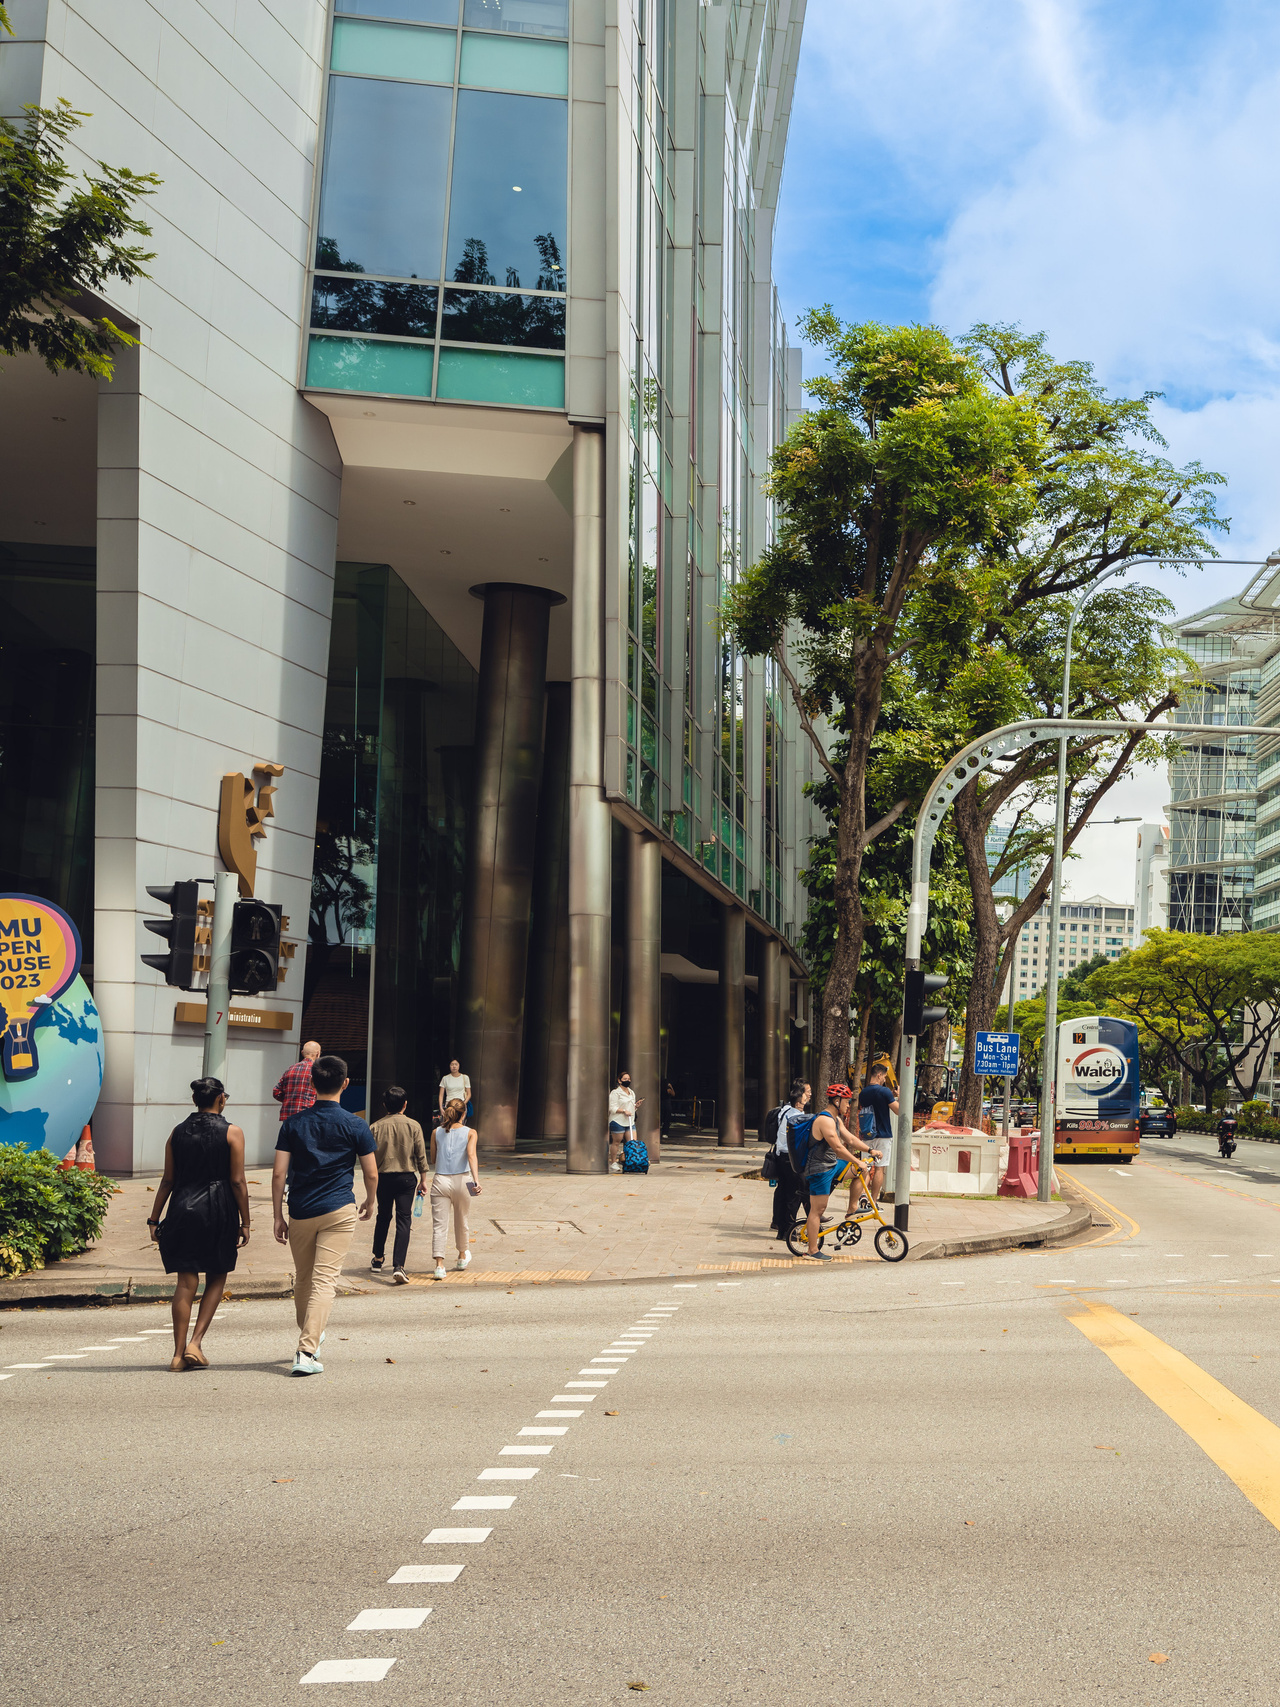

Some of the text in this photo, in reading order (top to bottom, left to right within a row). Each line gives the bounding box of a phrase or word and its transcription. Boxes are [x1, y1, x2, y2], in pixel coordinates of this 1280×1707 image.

[0, 917, 42, 939] MU
[0, 939, 42, 956] PEN
[0, 973, 42, 990] 023
[216, 1011, 223, 1025] 7
[1076, 1033, 1083, 1044] 12
[977, 1041, 1017, 1054] Bus Lane
[905, 1057, 911, 1067] 6
[1075, 1066, 1122, 1077] Walch
[1078, 1120, 1110, 1130] 99.9%
